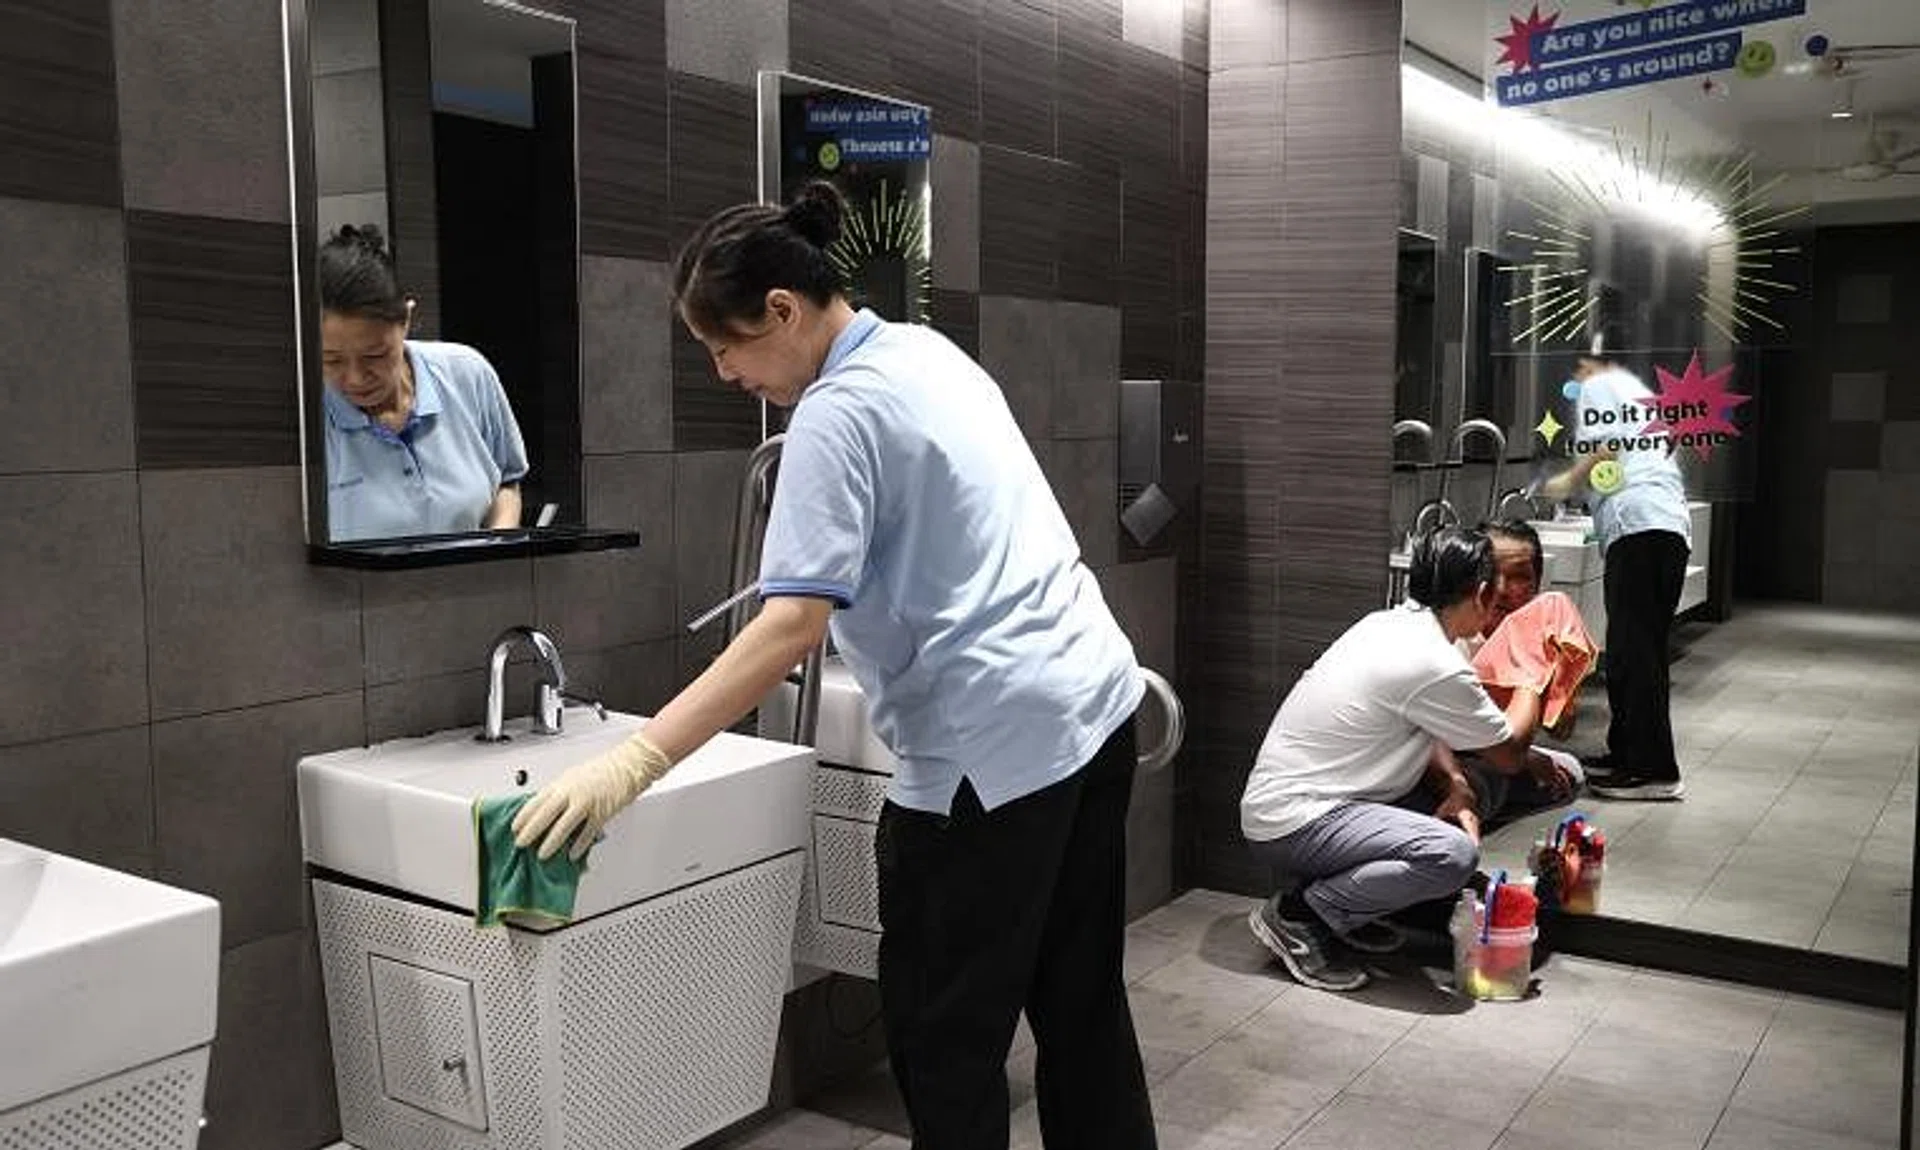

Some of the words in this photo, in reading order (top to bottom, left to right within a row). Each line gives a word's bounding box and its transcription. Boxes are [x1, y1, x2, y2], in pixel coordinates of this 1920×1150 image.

[1541, 32, 1587, 54] Are
[1592, 22, 1642, 50] you
[1649, 11, 1706, 34] nice
[1506, 79, 1537, 99] no
[1545, 66, 1612, 92] one's
[1618, 41, 1731, 80] around?
[1584, 407, 1617, 426] Do
[1622, 402, 1639, 424] it
[1645, 400, 1709, 425] right
[1565, 438, 1606, 454] for
[1607, 431, 1730, 460] everyone
